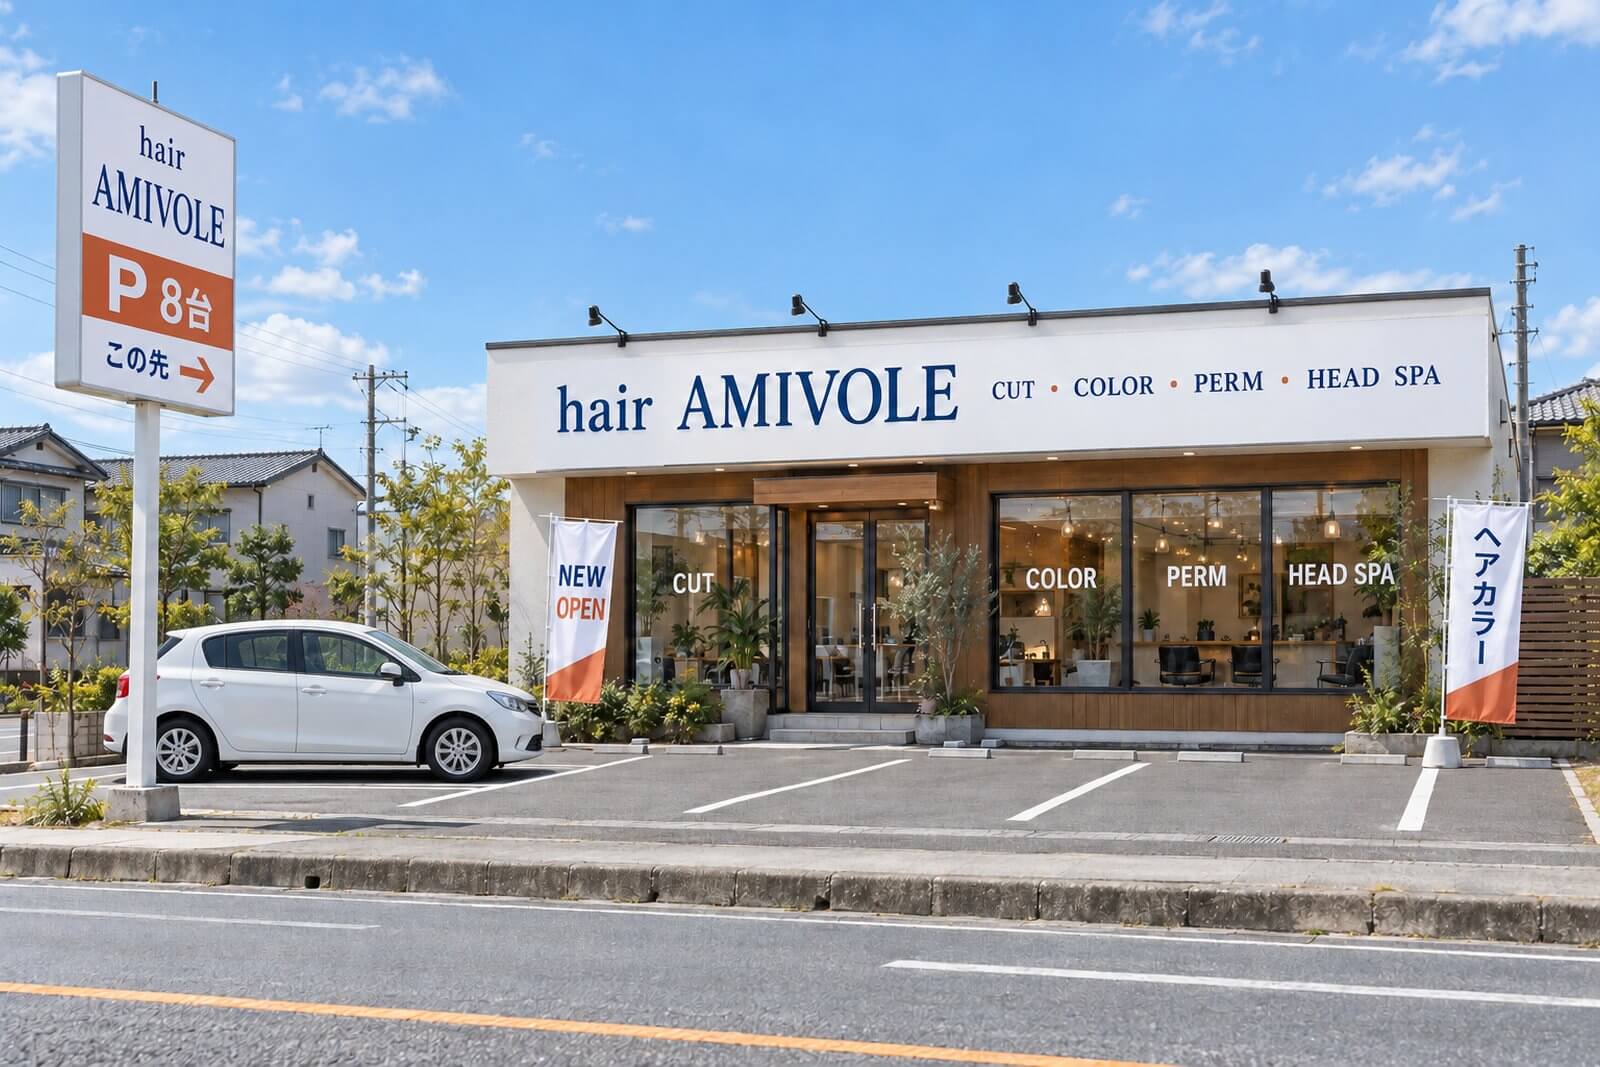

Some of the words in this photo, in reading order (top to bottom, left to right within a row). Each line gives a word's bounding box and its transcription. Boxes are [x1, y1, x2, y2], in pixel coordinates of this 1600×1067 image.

[139, 125, 185, 171] hair
[92, 163, 225, 249] AMIVOLE
[108, 254, 148, 313] P
[160, 277, 213, 333] 8台
[106, 341, 169, 380] この先
[556, 383, 653, 433] hair
[676, 364, 959, 430] AMIVOLE
[991, 379, 1036, 401] CUT
[1073, 375, 1155, 398] COLOR
[1193, 370, 1264, 393] PERM
[1307, 366, 1380, 390] HEAD
[1393, 364, 1442, 387] SPA
[558, 564, 606, 588] NEW
[672, 572, 715, 594] CUT
[1025, 566, 1097, 590] COLOR
[1167, 565, 1227, 588] PERM
[1288, 563, 1348, 586] HEAD
[1354, 562, 1395, 586] SPA
[556, 596, 606, 621] OPEN
[1471, 527, 1502, 665] ヘアカラー
